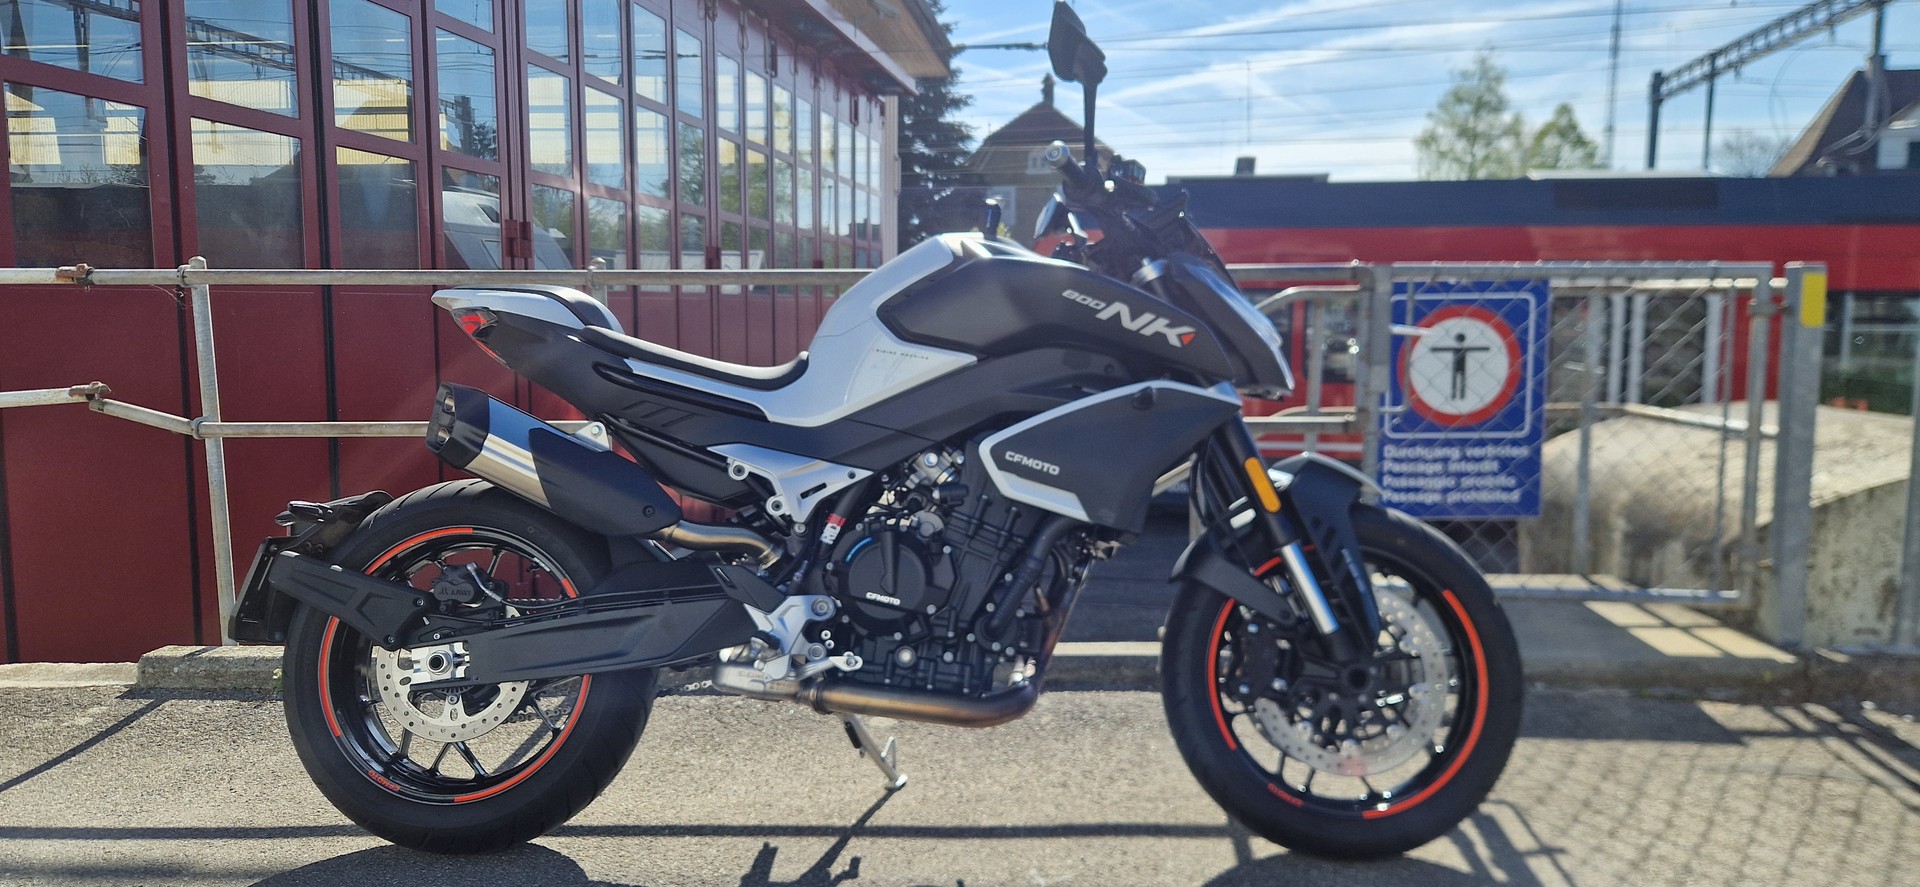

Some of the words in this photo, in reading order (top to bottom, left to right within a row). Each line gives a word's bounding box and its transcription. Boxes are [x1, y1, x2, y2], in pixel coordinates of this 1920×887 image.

[1062, 289, 1106, 310] 800
[1095, 301, 1196, 348] NK
[1384, 445, 1460, 460] Durchgang
[1465, 445, 1530, 458] verboten
[1005, 451, 1060, 475] CFMOTO
[1383, 460, 1443, 474] Passage
[1447, 460, 1499, 473] interdit
[1383, 475, 1457, 489] Passaggio
[1382, 489, 1442, 504] Passage
[1446, 489, 1521, 504] prohibited
[865, 592, 901, 606] CFMOTO
